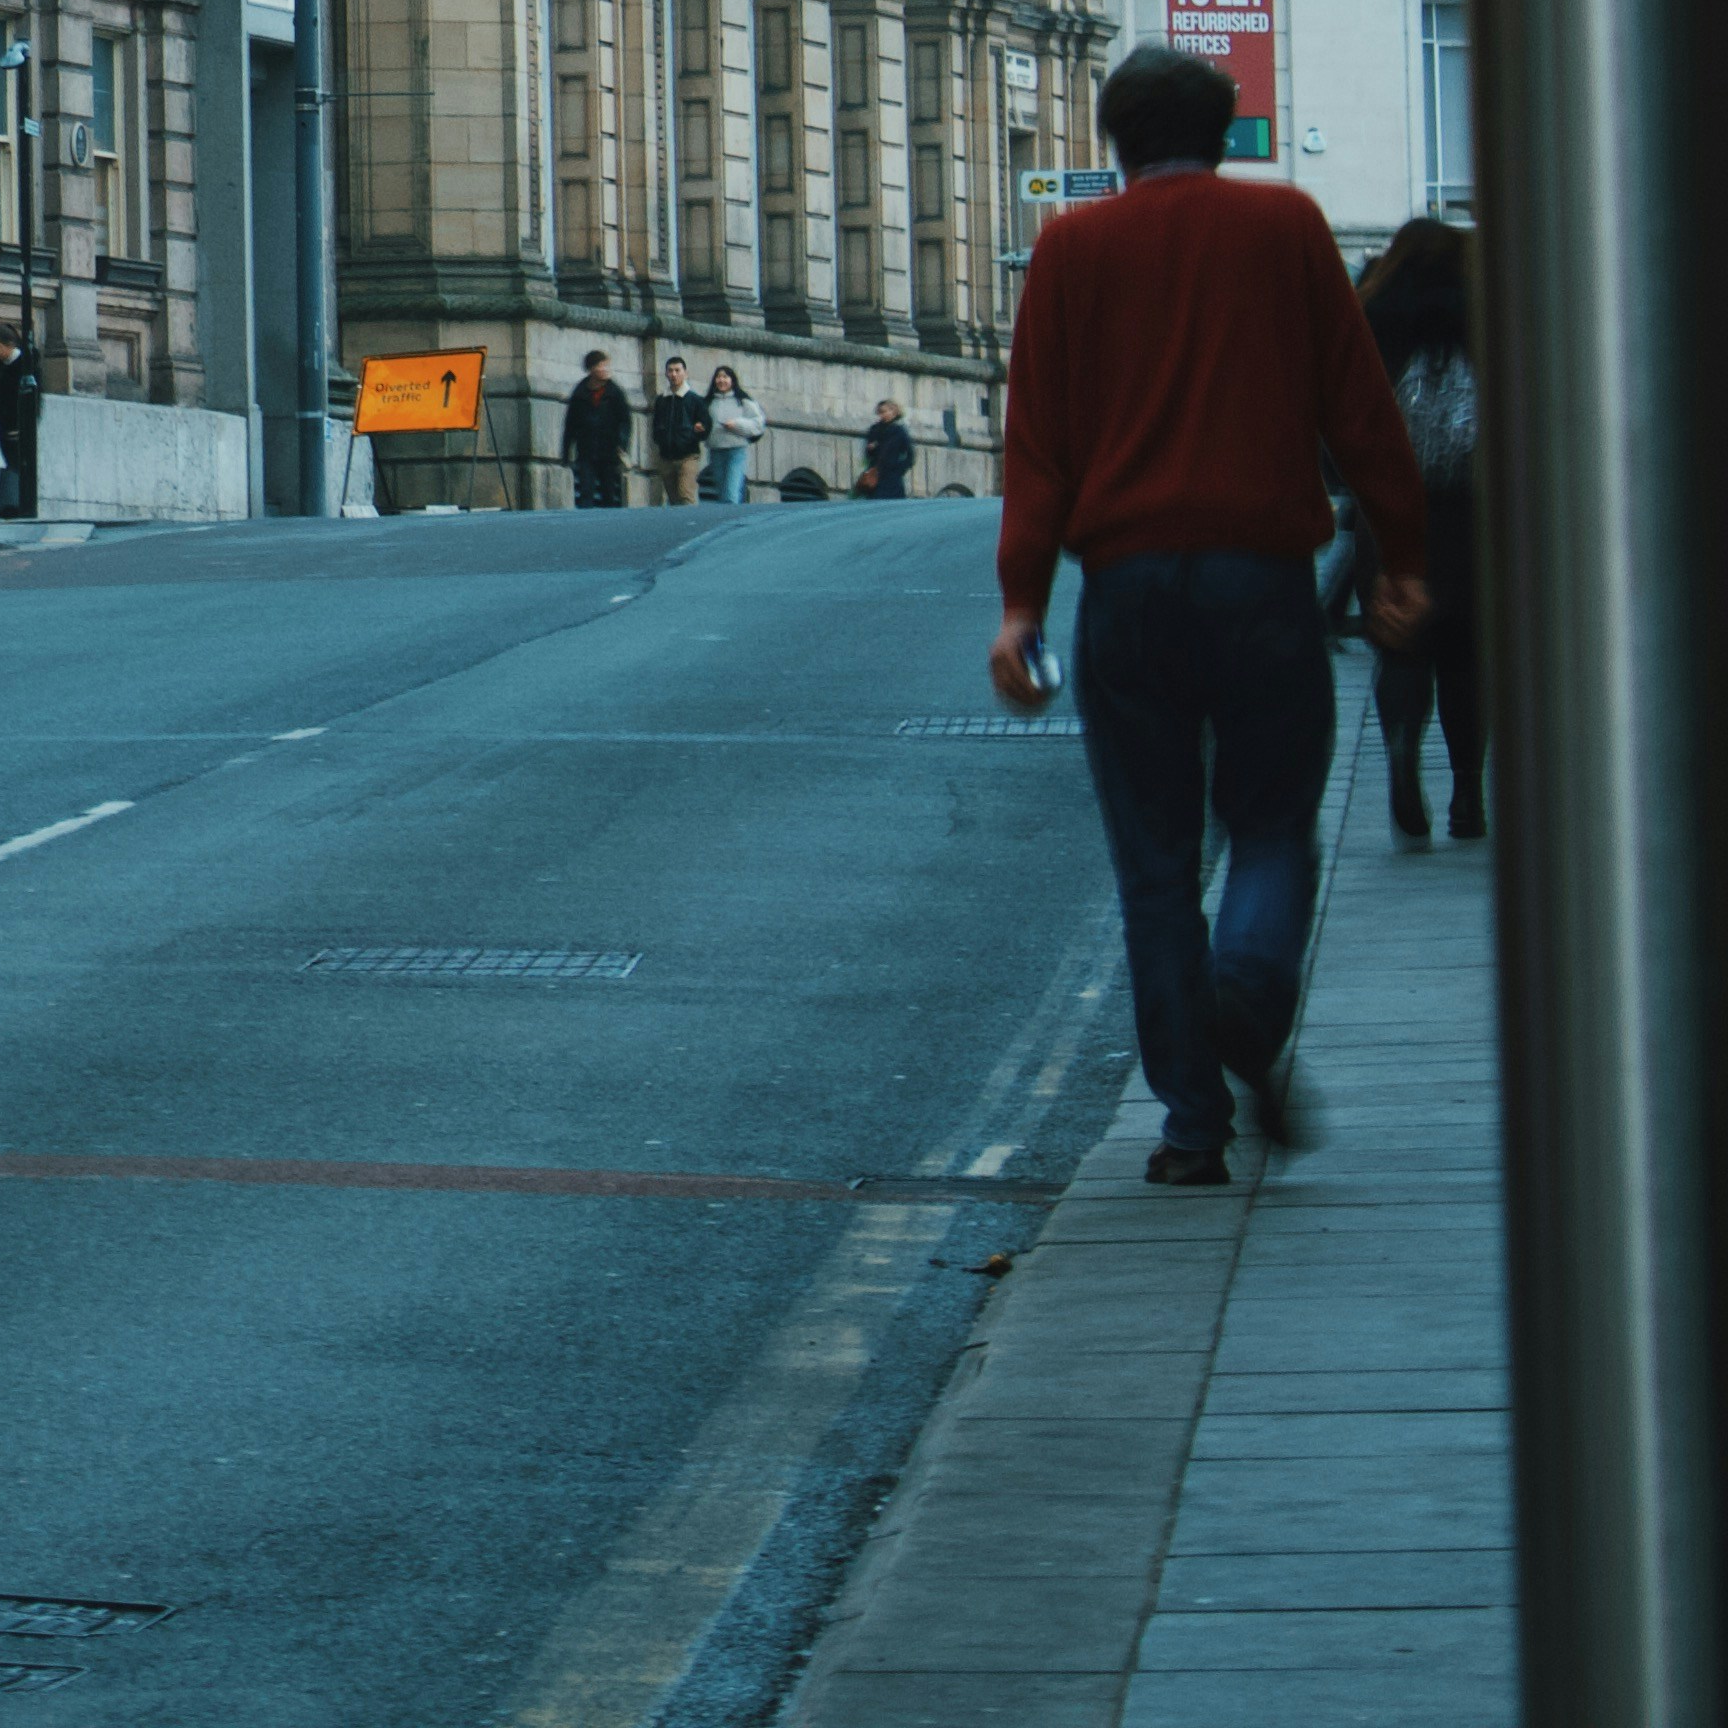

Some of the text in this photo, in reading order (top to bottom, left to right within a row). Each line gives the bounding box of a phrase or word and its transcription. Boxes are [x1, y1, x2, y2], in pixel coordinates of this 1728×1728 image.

[1172, 10, 1269, 33] REFURBISHED
[1173, 34, 1231, 56] OFFICES
[375, 380, 431, 393] Diverted
[382, 392, 421, 404] traffic
